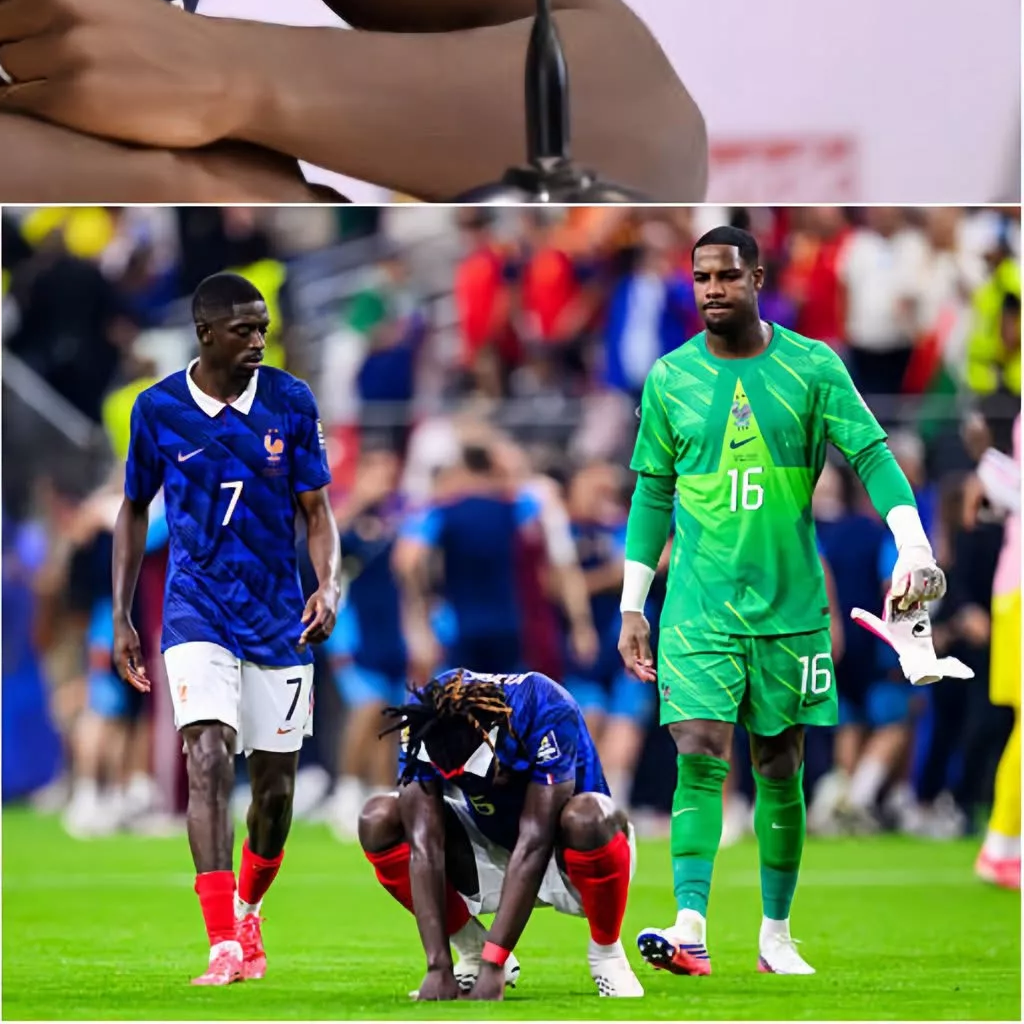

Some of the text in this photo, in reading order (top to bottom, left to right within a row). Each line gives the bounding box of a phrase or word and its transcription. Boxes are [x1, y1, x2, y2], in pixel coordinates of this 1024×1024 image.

[220, 480, 244, 526] 7
[727, 466, 764, 513] 16
[799, 652, 832, 695] 16
[285, 677, 302, 721] 7
